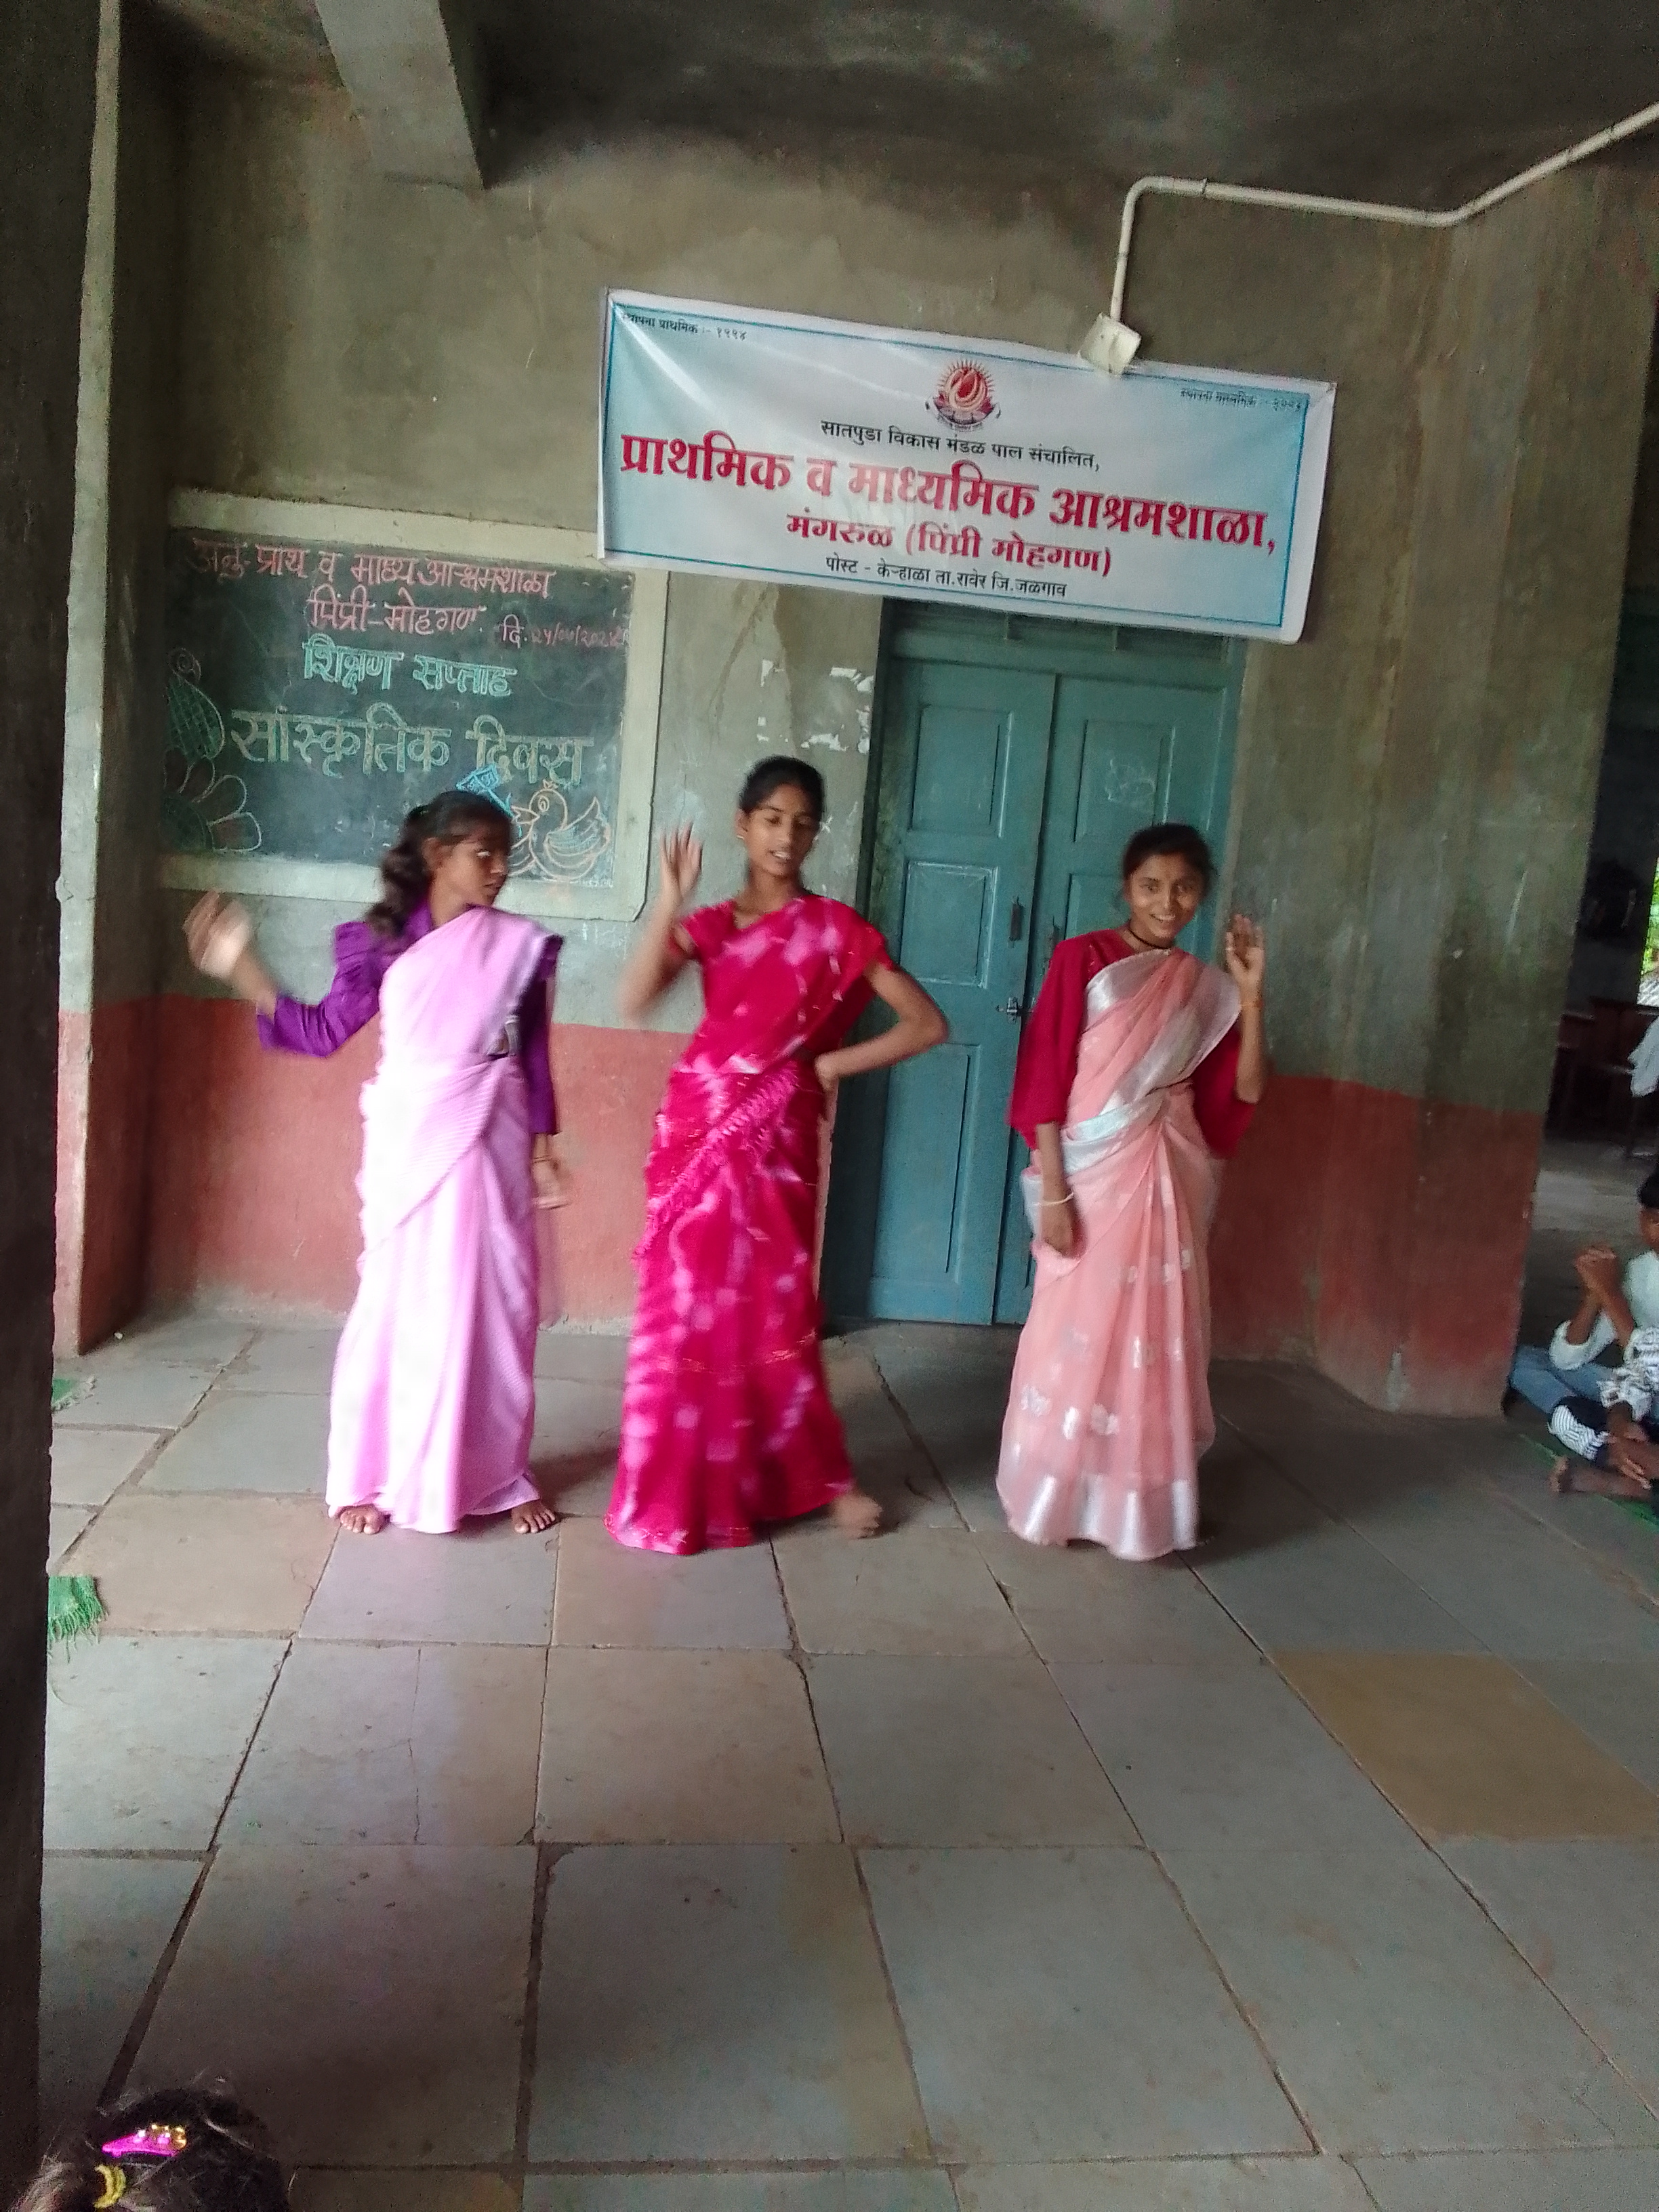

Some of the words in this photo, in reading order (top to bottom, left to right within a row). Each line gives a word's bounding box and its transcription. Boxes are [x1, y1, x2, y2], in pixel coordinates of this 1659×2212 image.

[659, 317, 699, 334] प्राथमिक
[821, 419, 882, 445] सातपुडा
[888, 426, 940, 451] विकास
[947, 433, 985, 455] मंडळ
[991, 443, 1024, 460] पाल
[1029, 442, 1100, 472] संचालित,
[620, 429, 794, 490] प्राथमिक
[806, 450, 838, 498] व
[848, 459, 1040, 519] माध्यमिक
[1048, 487, 1276, 556] आश्रमशाळा,
[785, 506, 893, 548] मंगरुळ
[319, 550, 344, 582] व
[825, 552, 859, 573] पोस्ट
[301, 633, 405, 696] शिक्षण
[412, 654, 518, 697] सप्ताह
[230, 701, 453, 779] सांस्कृतिक
[465, 714, 595, 786] दिवस
